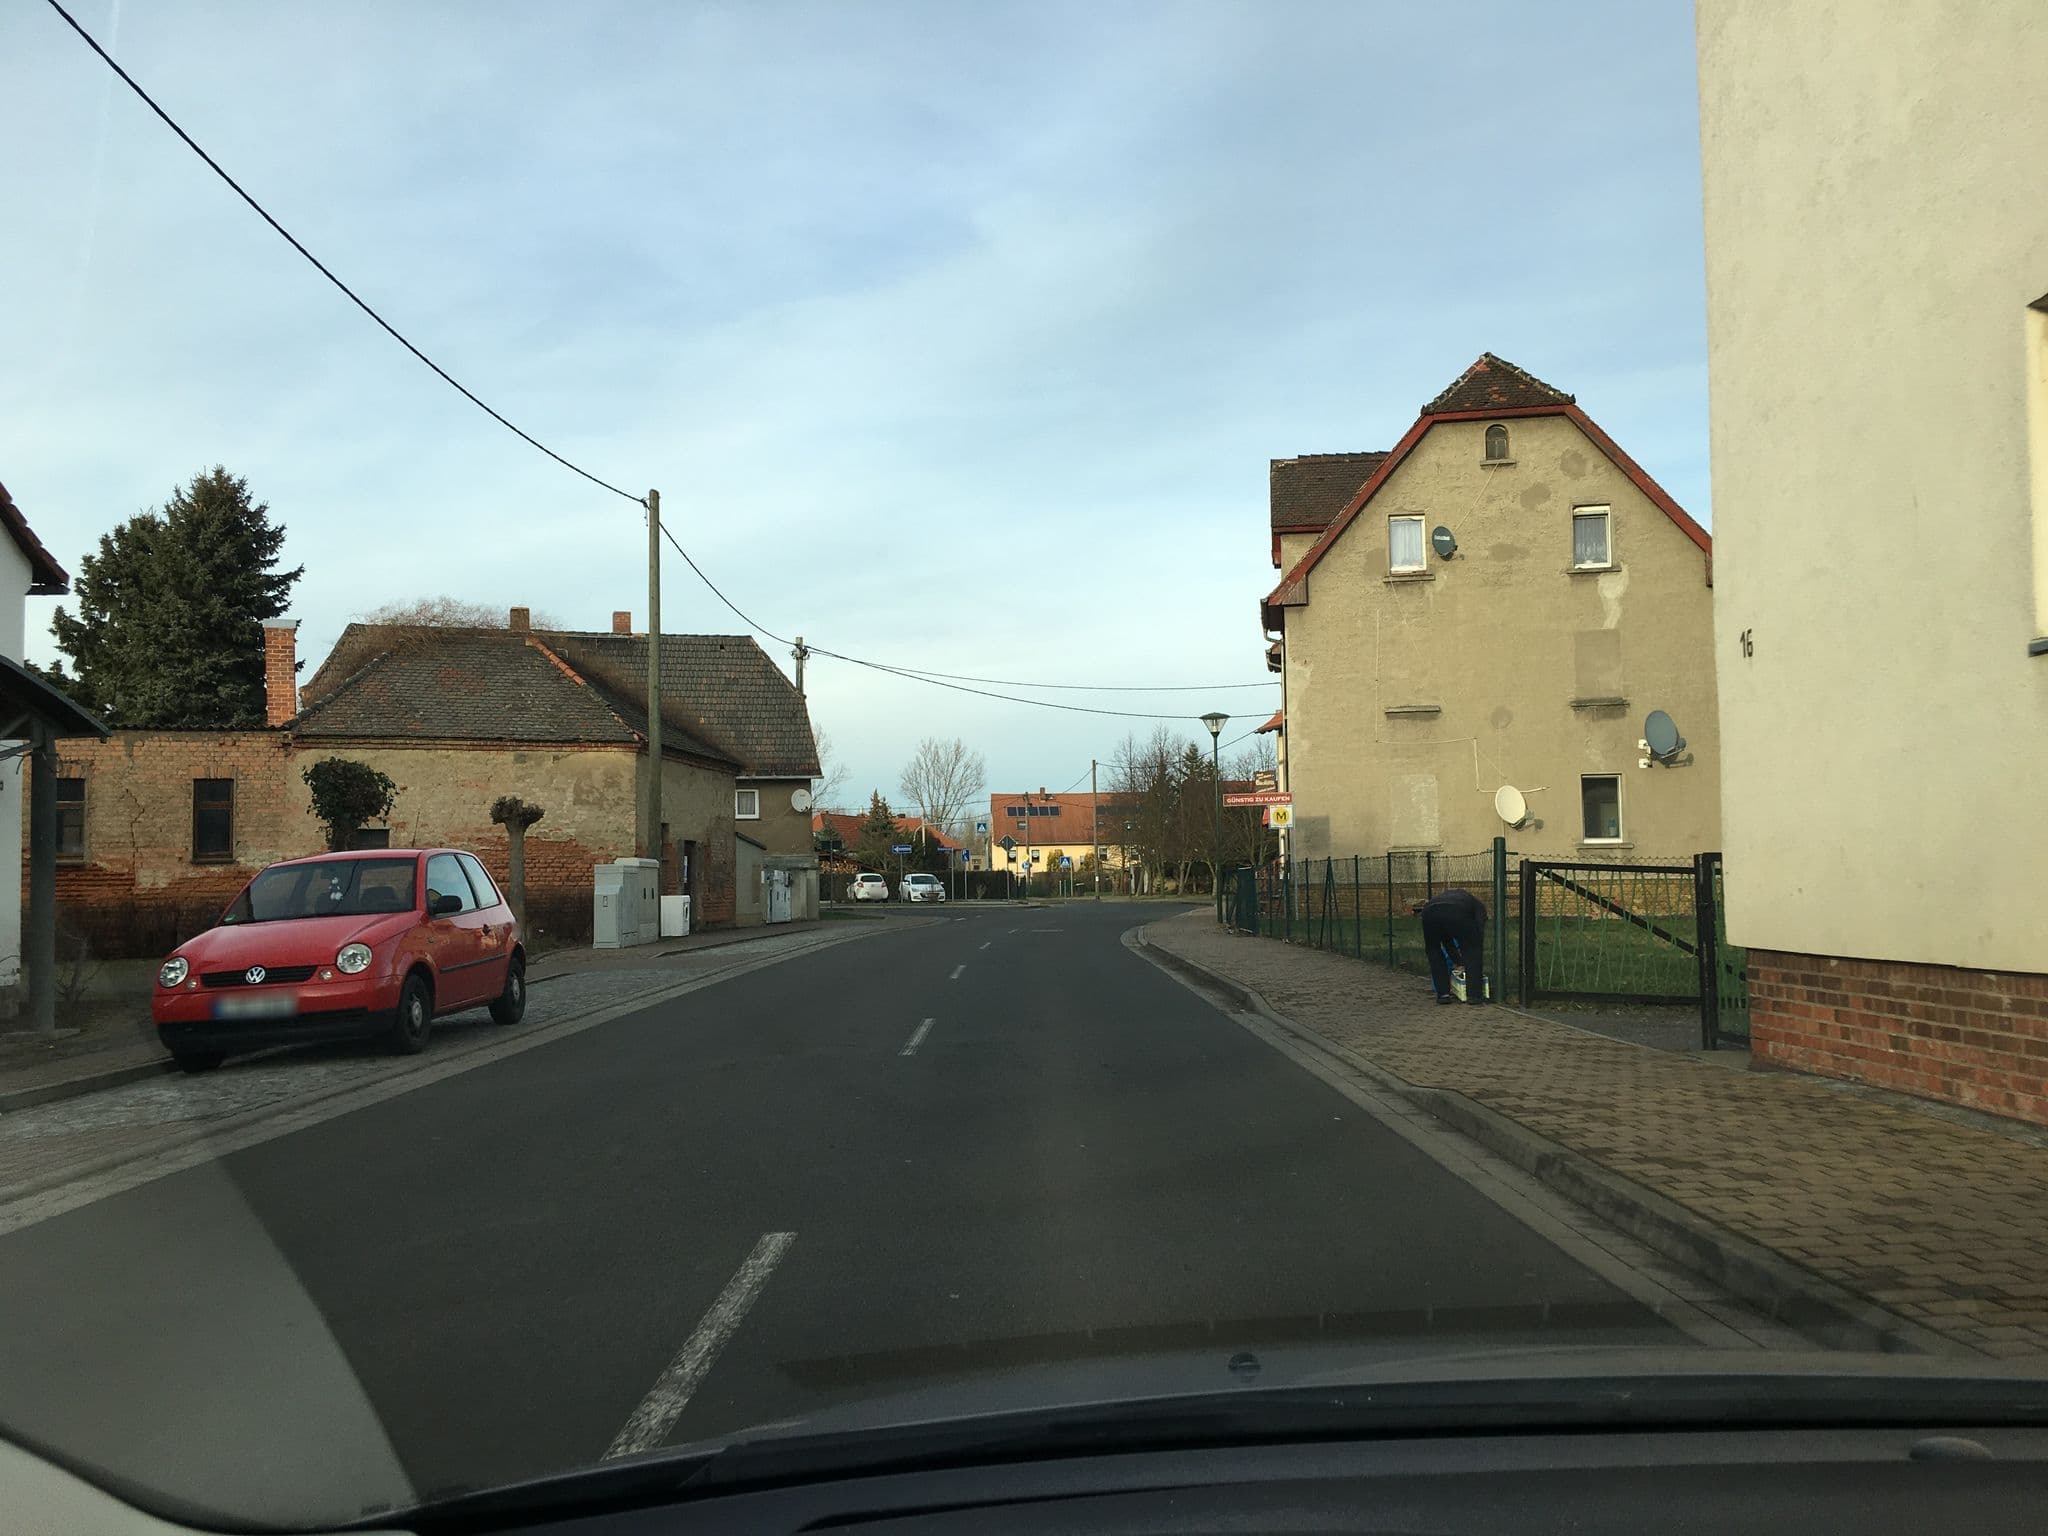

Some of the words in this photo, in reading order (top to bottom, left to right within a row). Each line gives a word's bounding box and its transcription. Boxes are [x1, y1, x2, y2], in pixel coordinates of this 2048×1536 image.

[1740, 628, 1753, 658] 16
[1276, 812, 1287, 821] M
[246, 967, 265, 983] VW
